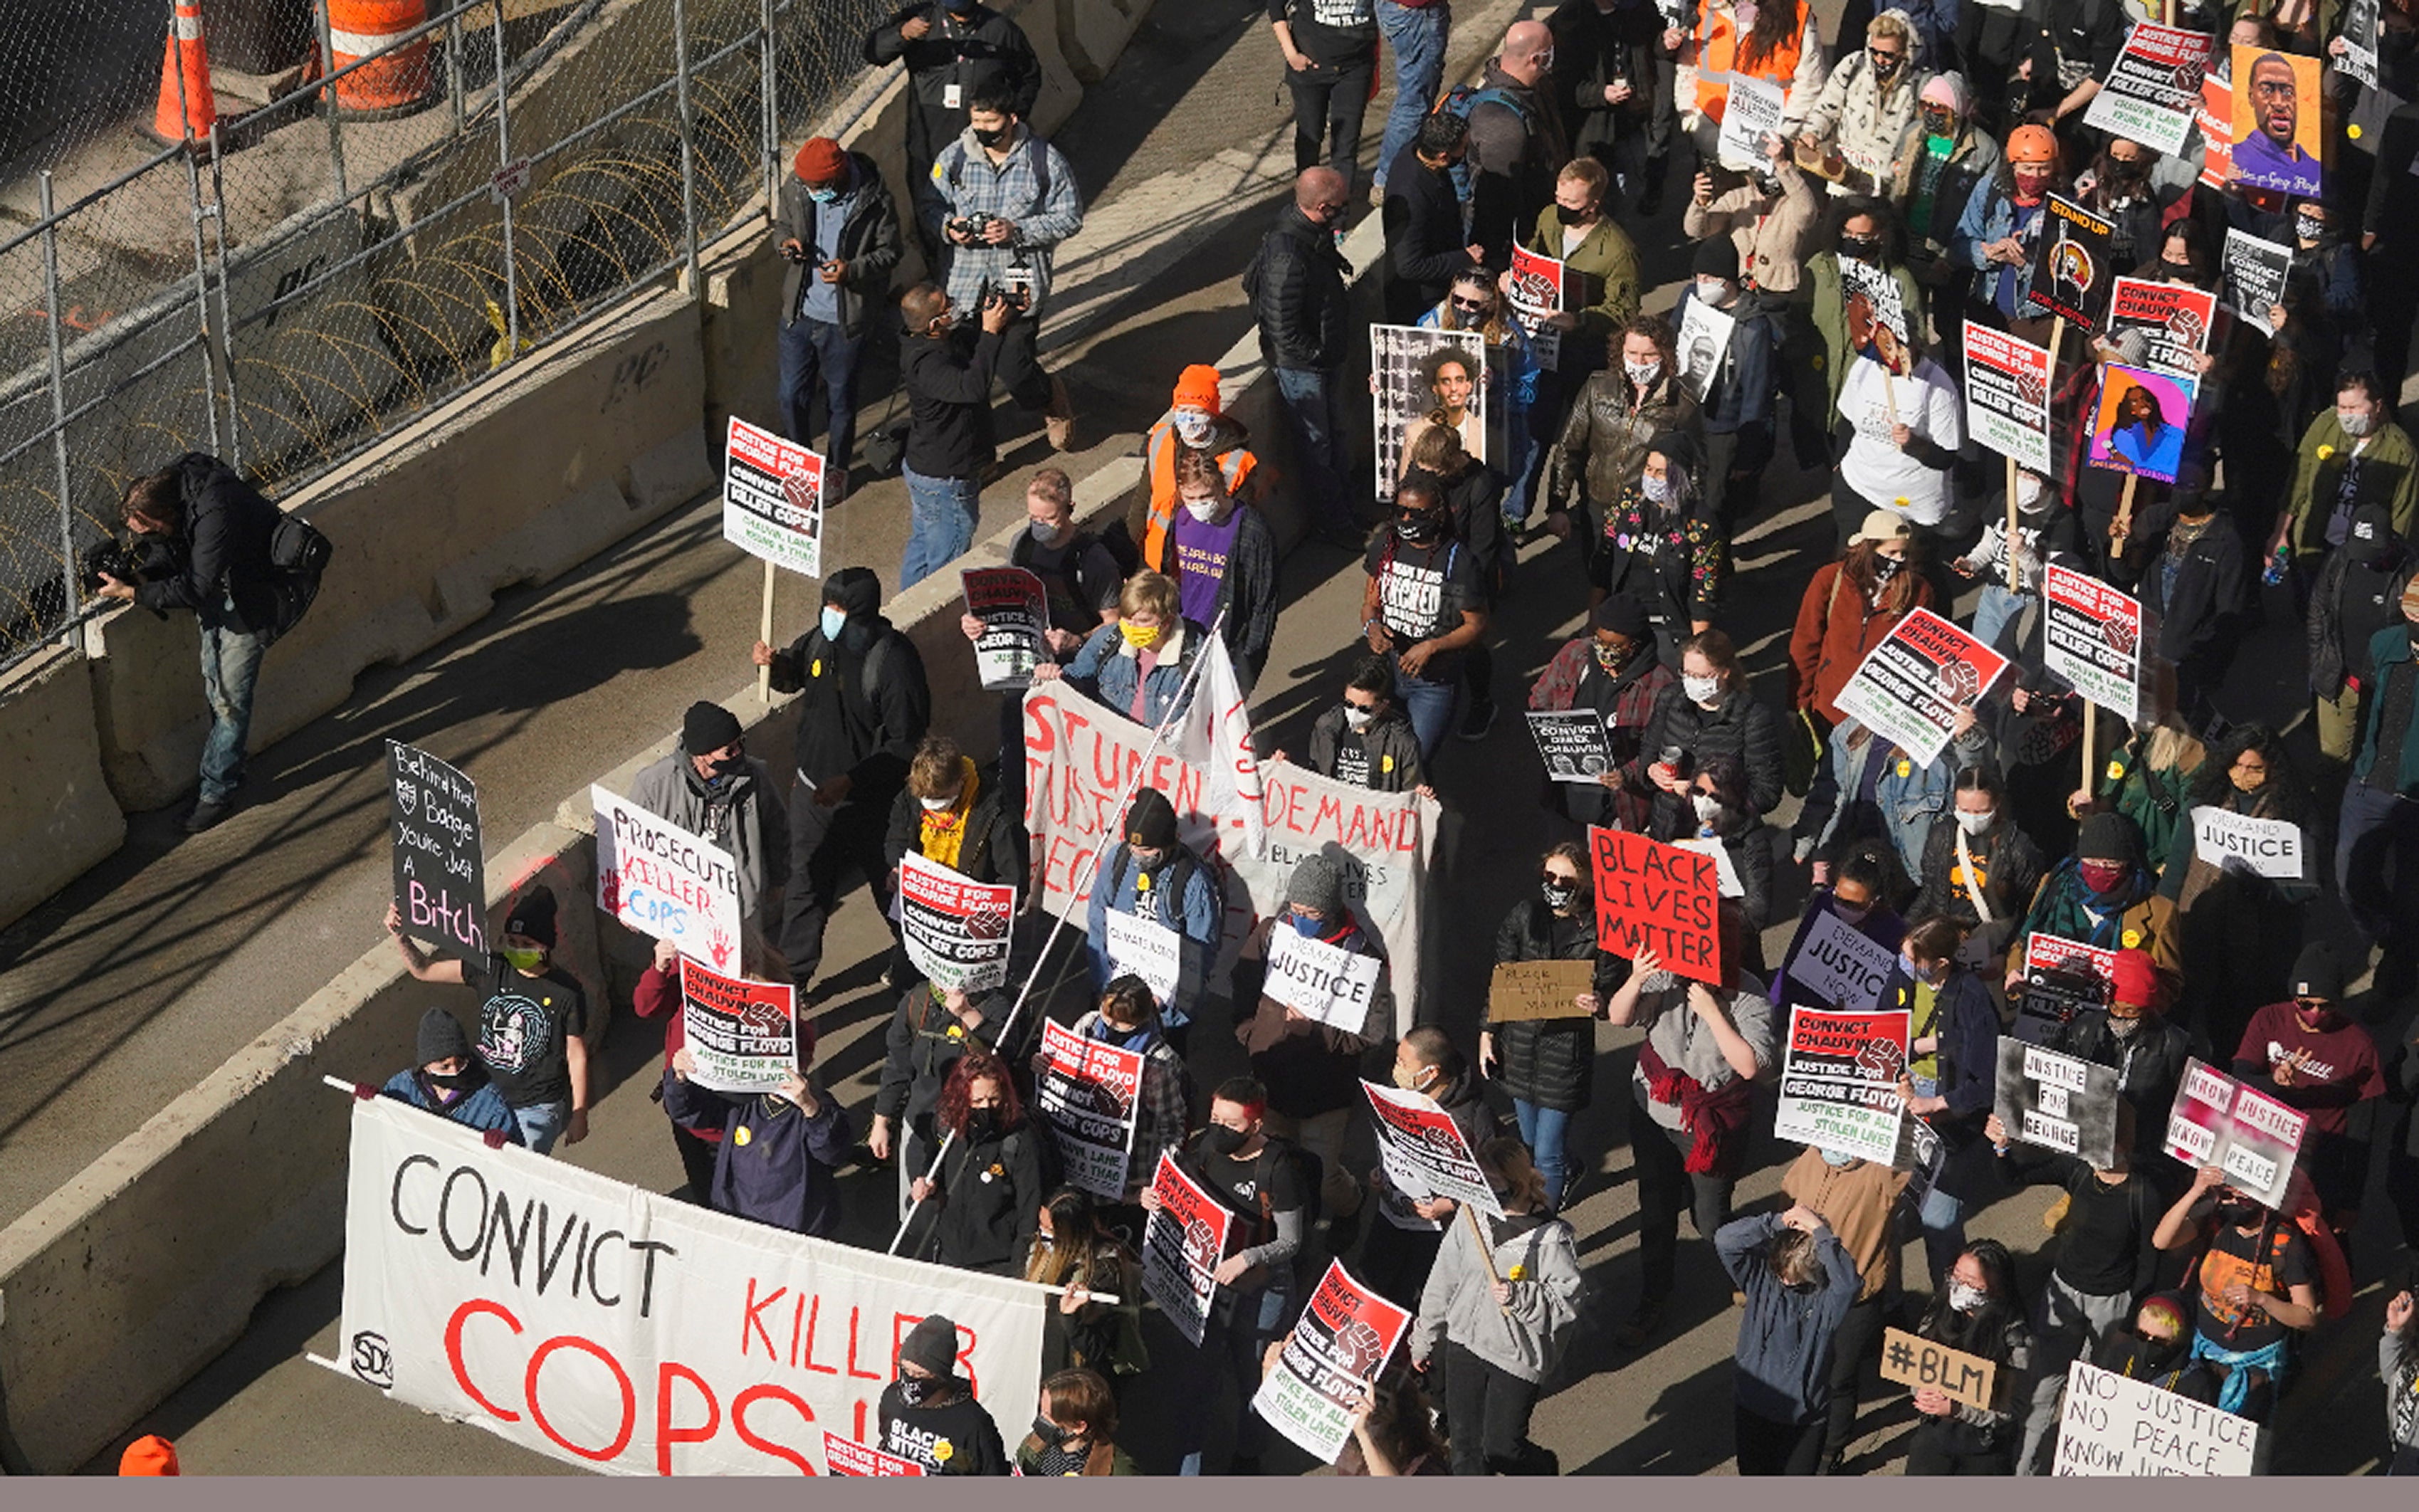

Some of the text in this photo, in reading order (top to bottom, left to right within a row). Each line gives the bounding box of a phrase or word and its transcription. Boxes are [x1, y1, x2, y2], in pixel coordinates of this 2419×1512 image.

[2137, 28, 2204, 49] JUSTICE FOR
[2110, 76, 2153, 97] KILLER
[2121, 60, 2174, 84] CONVICT
[2050, 200, 2109, 236] STAND UP
[1836, 251, 1856, 278] WE
[2230, 256, 2282, 280] CONVICT
[2120, 286, 2181, 304] CONVICT
[1966, 340, 2046, 379] GEORGE FLOYD
[1969, 330, 2032, 363] JUSTICE FOR
[1971, 365, 2019, 394] CONVICT
[1972, 387, 2042, 426] KILLER COPS
[730, 437, 818, 483] GEORGE FLOYD
[733, 426, 804, 466] JUSTICE FOR
[731, 465, 785, 498] CONVICT
[730, 484, 812, 530] KILLER COPS
[2050, 582, 2137, 626] GEORGE FLOYD
[2051, 572, 2124, 609] JUSTICE FOR
[1912, 616, 1972, 652] CONVICT
[2052, 608, 2104, 639] CONVICT
[1901, 626, 1961, 665] CHAUVIN
[2050, 629, 2129, 675] KILLER COPS
[1882, 643, 1955, 698] JUSTICE FOR
[1864, 663, 1955, 729] GEORGE FLOYD
[1540, 725, 1597, 736] CONVICT
[1543, 745, 1602, 753] CHAUVIN
[394, 746, 448, 794] Behind
[424, 789, 473, 847] Badge
[1264, 778, 1418, 852] DEMAND
[2213, 812, 2280, 836] DEMAND
[614, 807, 735, 896] PROSECUTE
[2203, 825, 2293, 856] JUSTICE
[403, 855, 415, 876] A
[1597, 834, 1713, 891] BLACK
[623, 848, 715, 919] KILLER
[903, 881, 1009, 912] GEORGE FLOYD
[905, 870, 993, 901] JUSTICE FOR
[409, 880, 483, 953] Bitch
[629, 890, 688, 934] COPS
[1601, 874, 1711, 930] LIVES
[906, 904, 967, 936] CONVICT
[955, 946, 997, 959] COPS
[1290, 935, 1360, 973] DEMAND
[1602, 911, 1714, 969] MATTER
[1832, 925, 1894, 974] DEMAND
[687, 967, 750, 998] CONVICT
[1273, 952, 1366, 1004] JUSTICE
[1823, 975, 1862, 1005] NOW
[1289, 987, 1330, 1011] NOW
[688, 1004, 770, 1036] JUSTICE FOR
[1798, 1017, 1871, 1035] CONVICT
[688, 1021, 790, 1054] GEORGE FLOYD
[1048, 1029, 1121, 1066] JUSTICE FOR
[1795, 1033, 1872, 1051] CHAUVIN
[743, 1059, 765, 1068] FOR
[1091, 1064, 1134, 1086] FLOYD
[1789, 1059, 1884, 1079] JUSTICE FOR
[2025, 1056, 2084, 1086] JUSTICE
[1041, 1076, 1093, 1106] CONVICT
[1785, 1081, 1898, 1109] GEORGE FLOYD
[2040, 1089, 2067, 1107] FOR
[2190, 1074, 2300, 1138] KNOW JUSTICE
[1081, 1120, 1122, 1143] COPS
[1797, 1102, 1894, 1130] JUSTICE FOR ALL
[2025, 1116, 2077, 1146] GEORGE
[1815, 1118, 1892, 1148] STOLEN LIVES
[2171, 1122, 2273, 1184] KNOW PEACE
[1161, 1165, 1200, 1210] CONVICT
[391, 1153, 678, 1318] CONVICT
[1325, 1271, 1365, 1312] CONVICT
[1326, 1343, 1353, 1370] FOR
[1887, 1341, 1984, 1402] #BLM
[1275, 1392, 1343, 1444] STOLEN LIVES
[1303, 1393, 1326, 1415] FOR
[1326, 1408, 1348, 1429] ALL
[2069, 1401, 2108, 1432] NO
[2076, 1367, 2250, 1452] NO JUSTICE,
[891, 1419, 950, 1450] BLACK
[827, 1437, 904, 1475] JUSTICE FOR
[2062, 1434, 2124, 1473] KNOW
